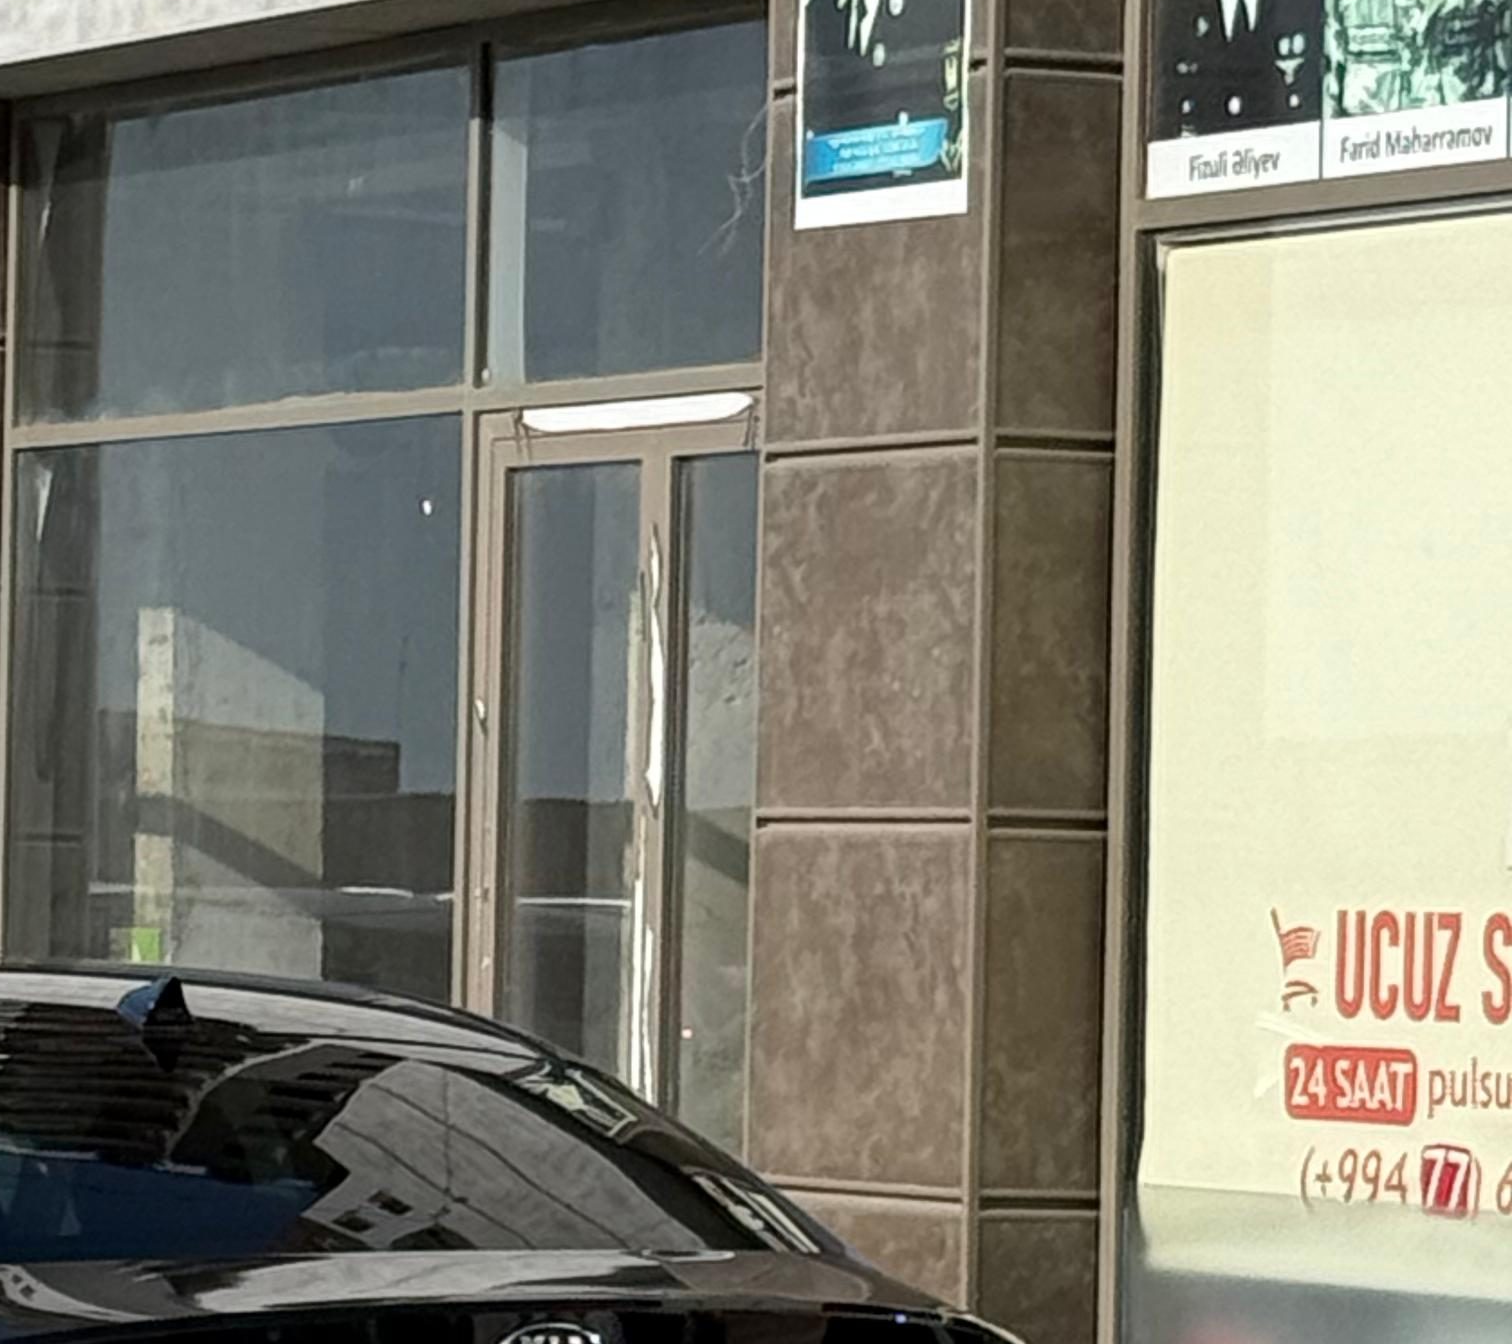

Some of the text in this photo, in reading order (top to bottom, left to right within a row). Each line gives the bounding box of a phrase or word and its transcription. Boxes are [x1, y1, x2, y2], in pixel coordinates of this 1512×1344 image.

[1335, 910, 1512, 1025] UCUZ S
[1290, 1056, 1512, 1119] 24 SAAT pulsu
[1301, 1146, 1408, 1214] (+994
[1421, 1144, 1482, 1220] 77)
